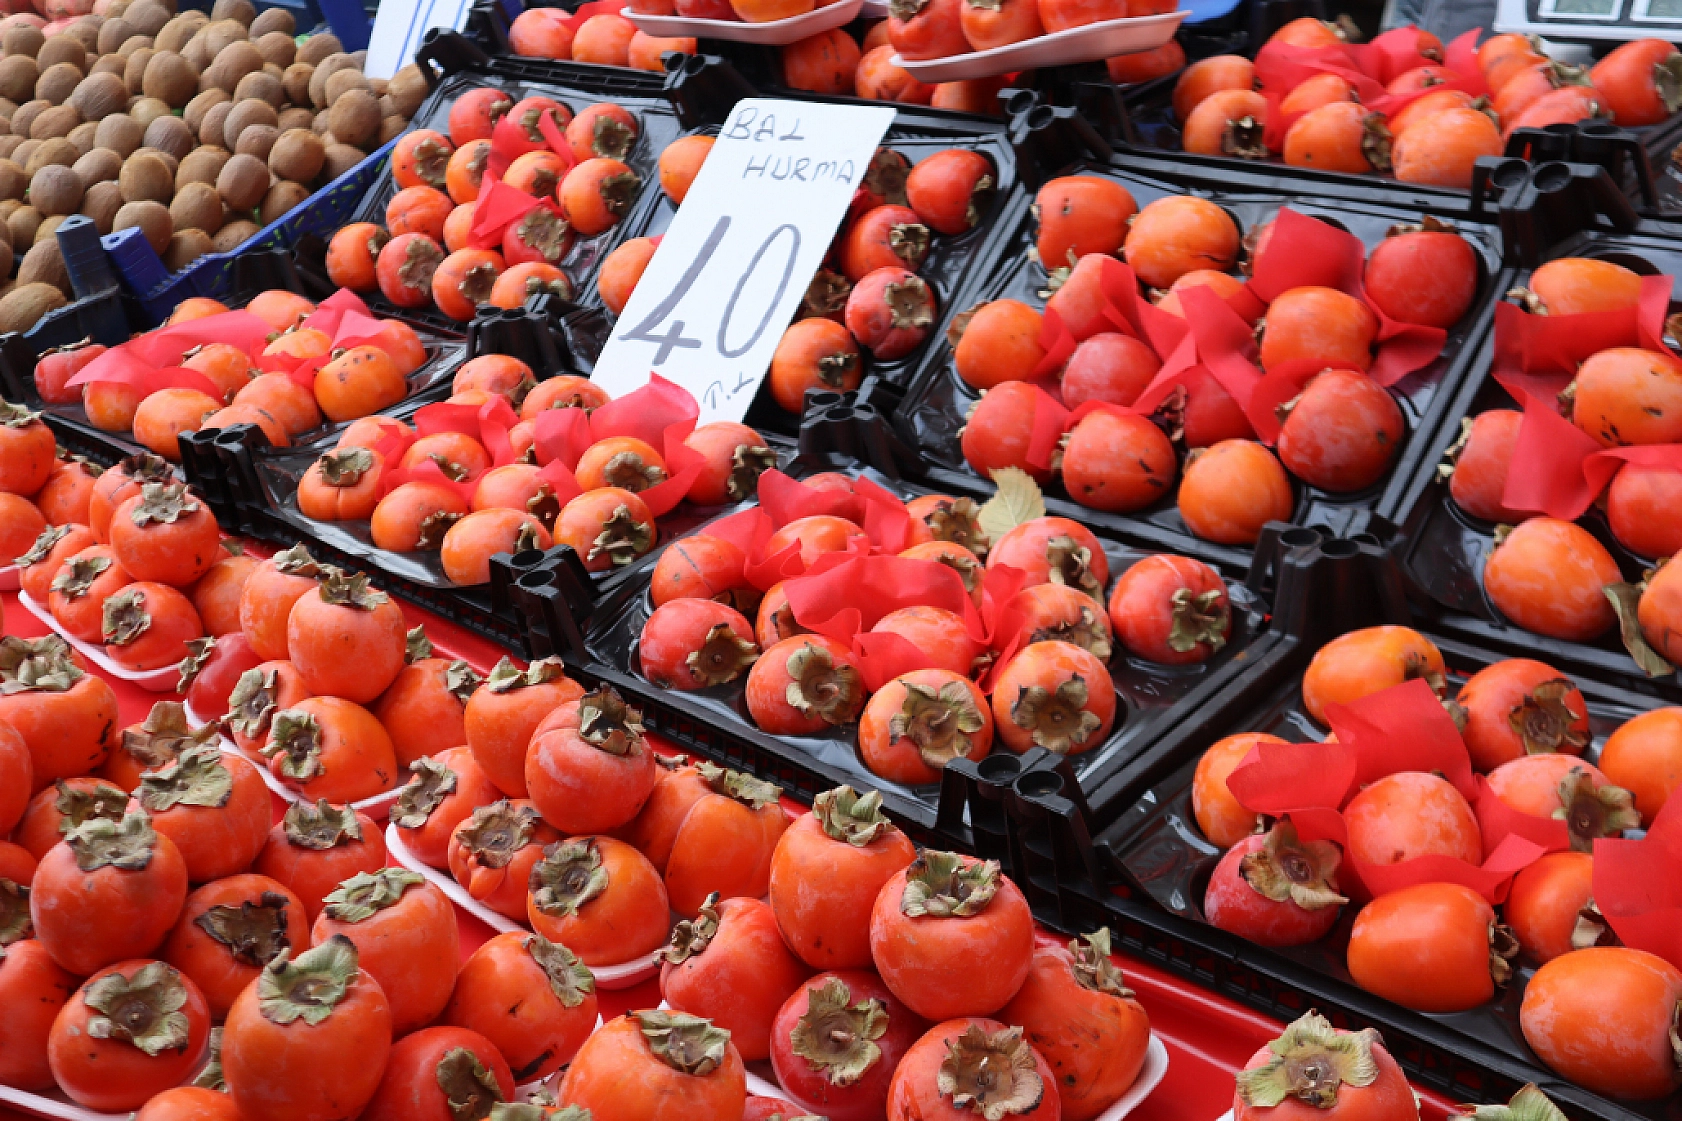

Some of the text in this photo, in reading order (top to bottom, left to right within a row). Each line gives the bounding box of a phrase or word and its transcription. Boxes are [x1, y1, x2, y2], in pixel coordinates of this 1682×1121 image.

[724, 107, 804, 142] BAL
[742, 154, 855, 184] HURMA
[618, 215, 801, 366] 40
